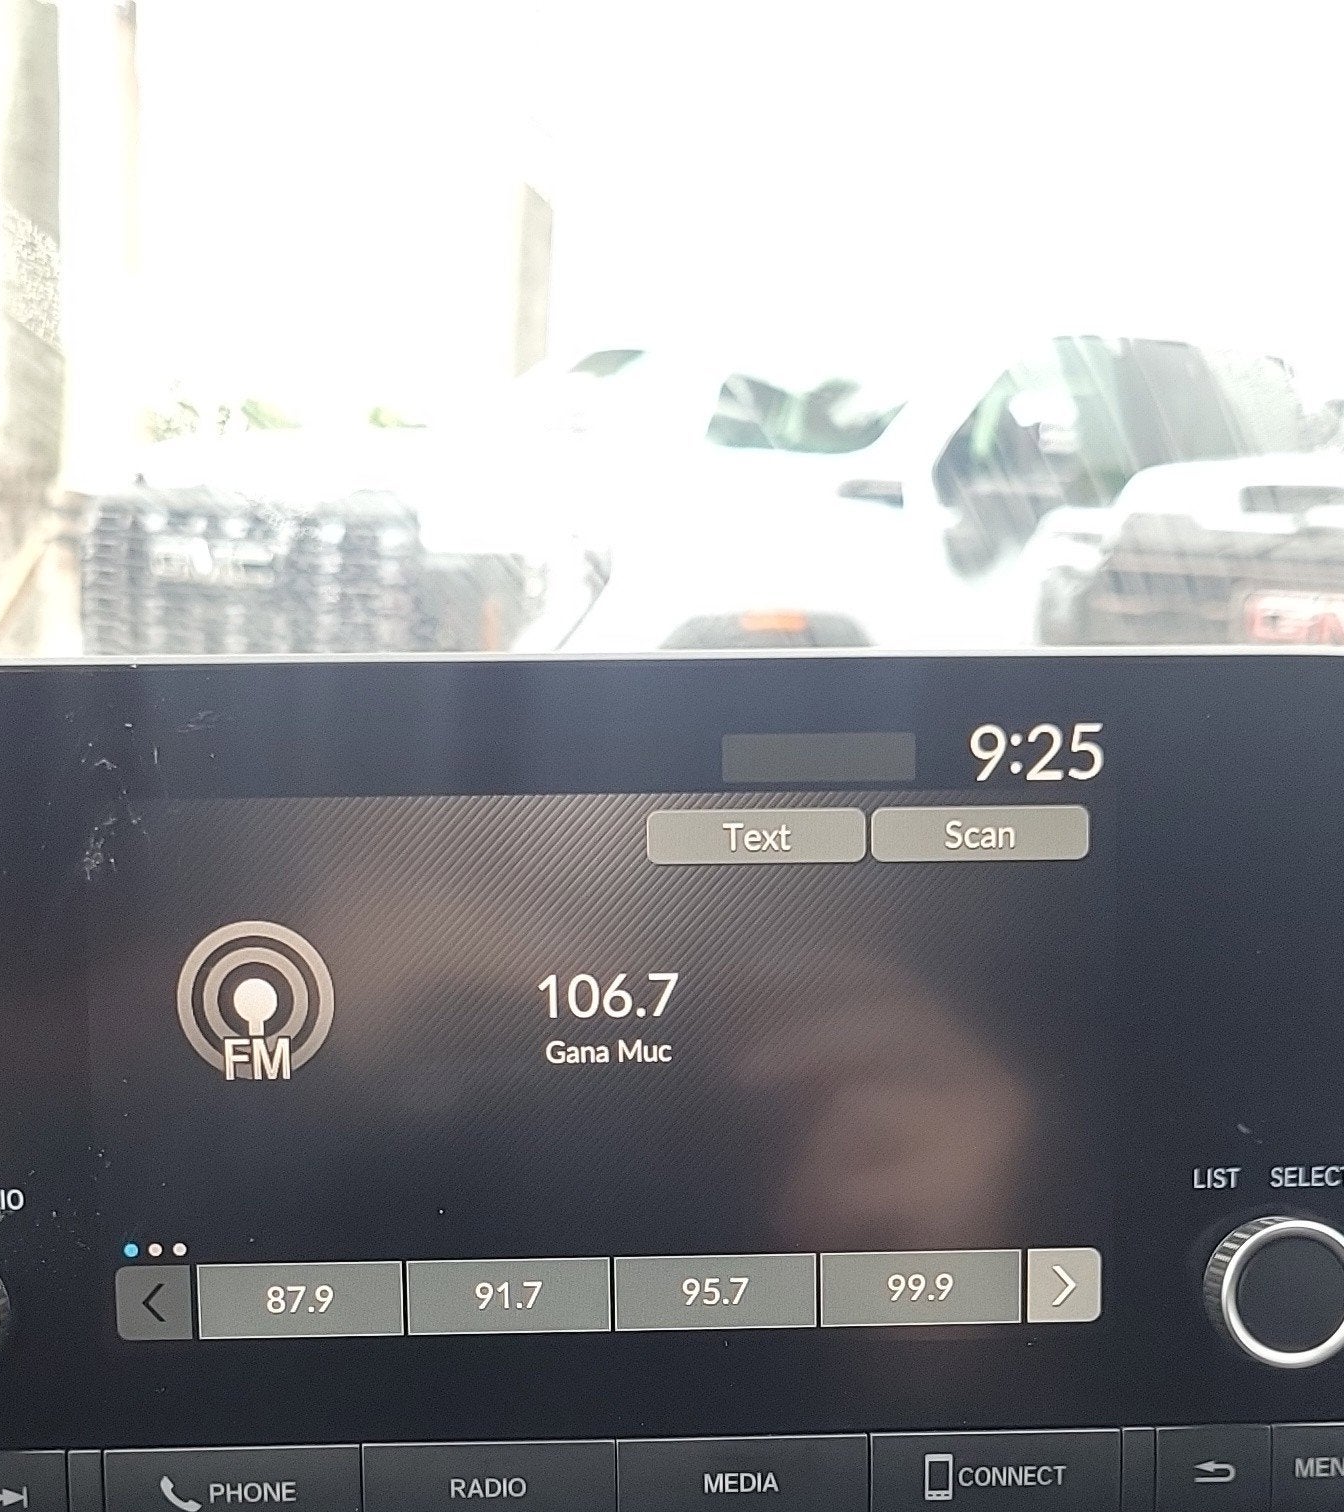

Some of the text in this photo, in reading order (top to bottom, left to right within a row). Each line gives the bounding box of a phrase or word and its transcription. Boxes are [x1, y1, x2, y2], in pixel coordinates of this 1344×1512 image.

[969, 722, 1105, 782] 9:25
[722, 823, 792, 852] Text
[944, 819, 1016, 850] Scan
[537, 972, 680, 1020] 106.7
[224, 1038, 292, 1081] FM
[545, 1038, 673, 1065] Gana Muc
[1192, 1167, 1241, 1189] LIST
[265, 1285, 335, 1315] 87.9
[473, 1281, 544, 1312] 91.7
[681, 1277, 750, 1307] 95.7
[886, 1273, 955, 1304] 99.9
[449, 1477, 527, 1499] RADIO
[702, 1472, 780, 1494] MEDIA
[958, 1465, 1068, 1488] CONNECT
[209, 1481, 296, 1504] PHONE
